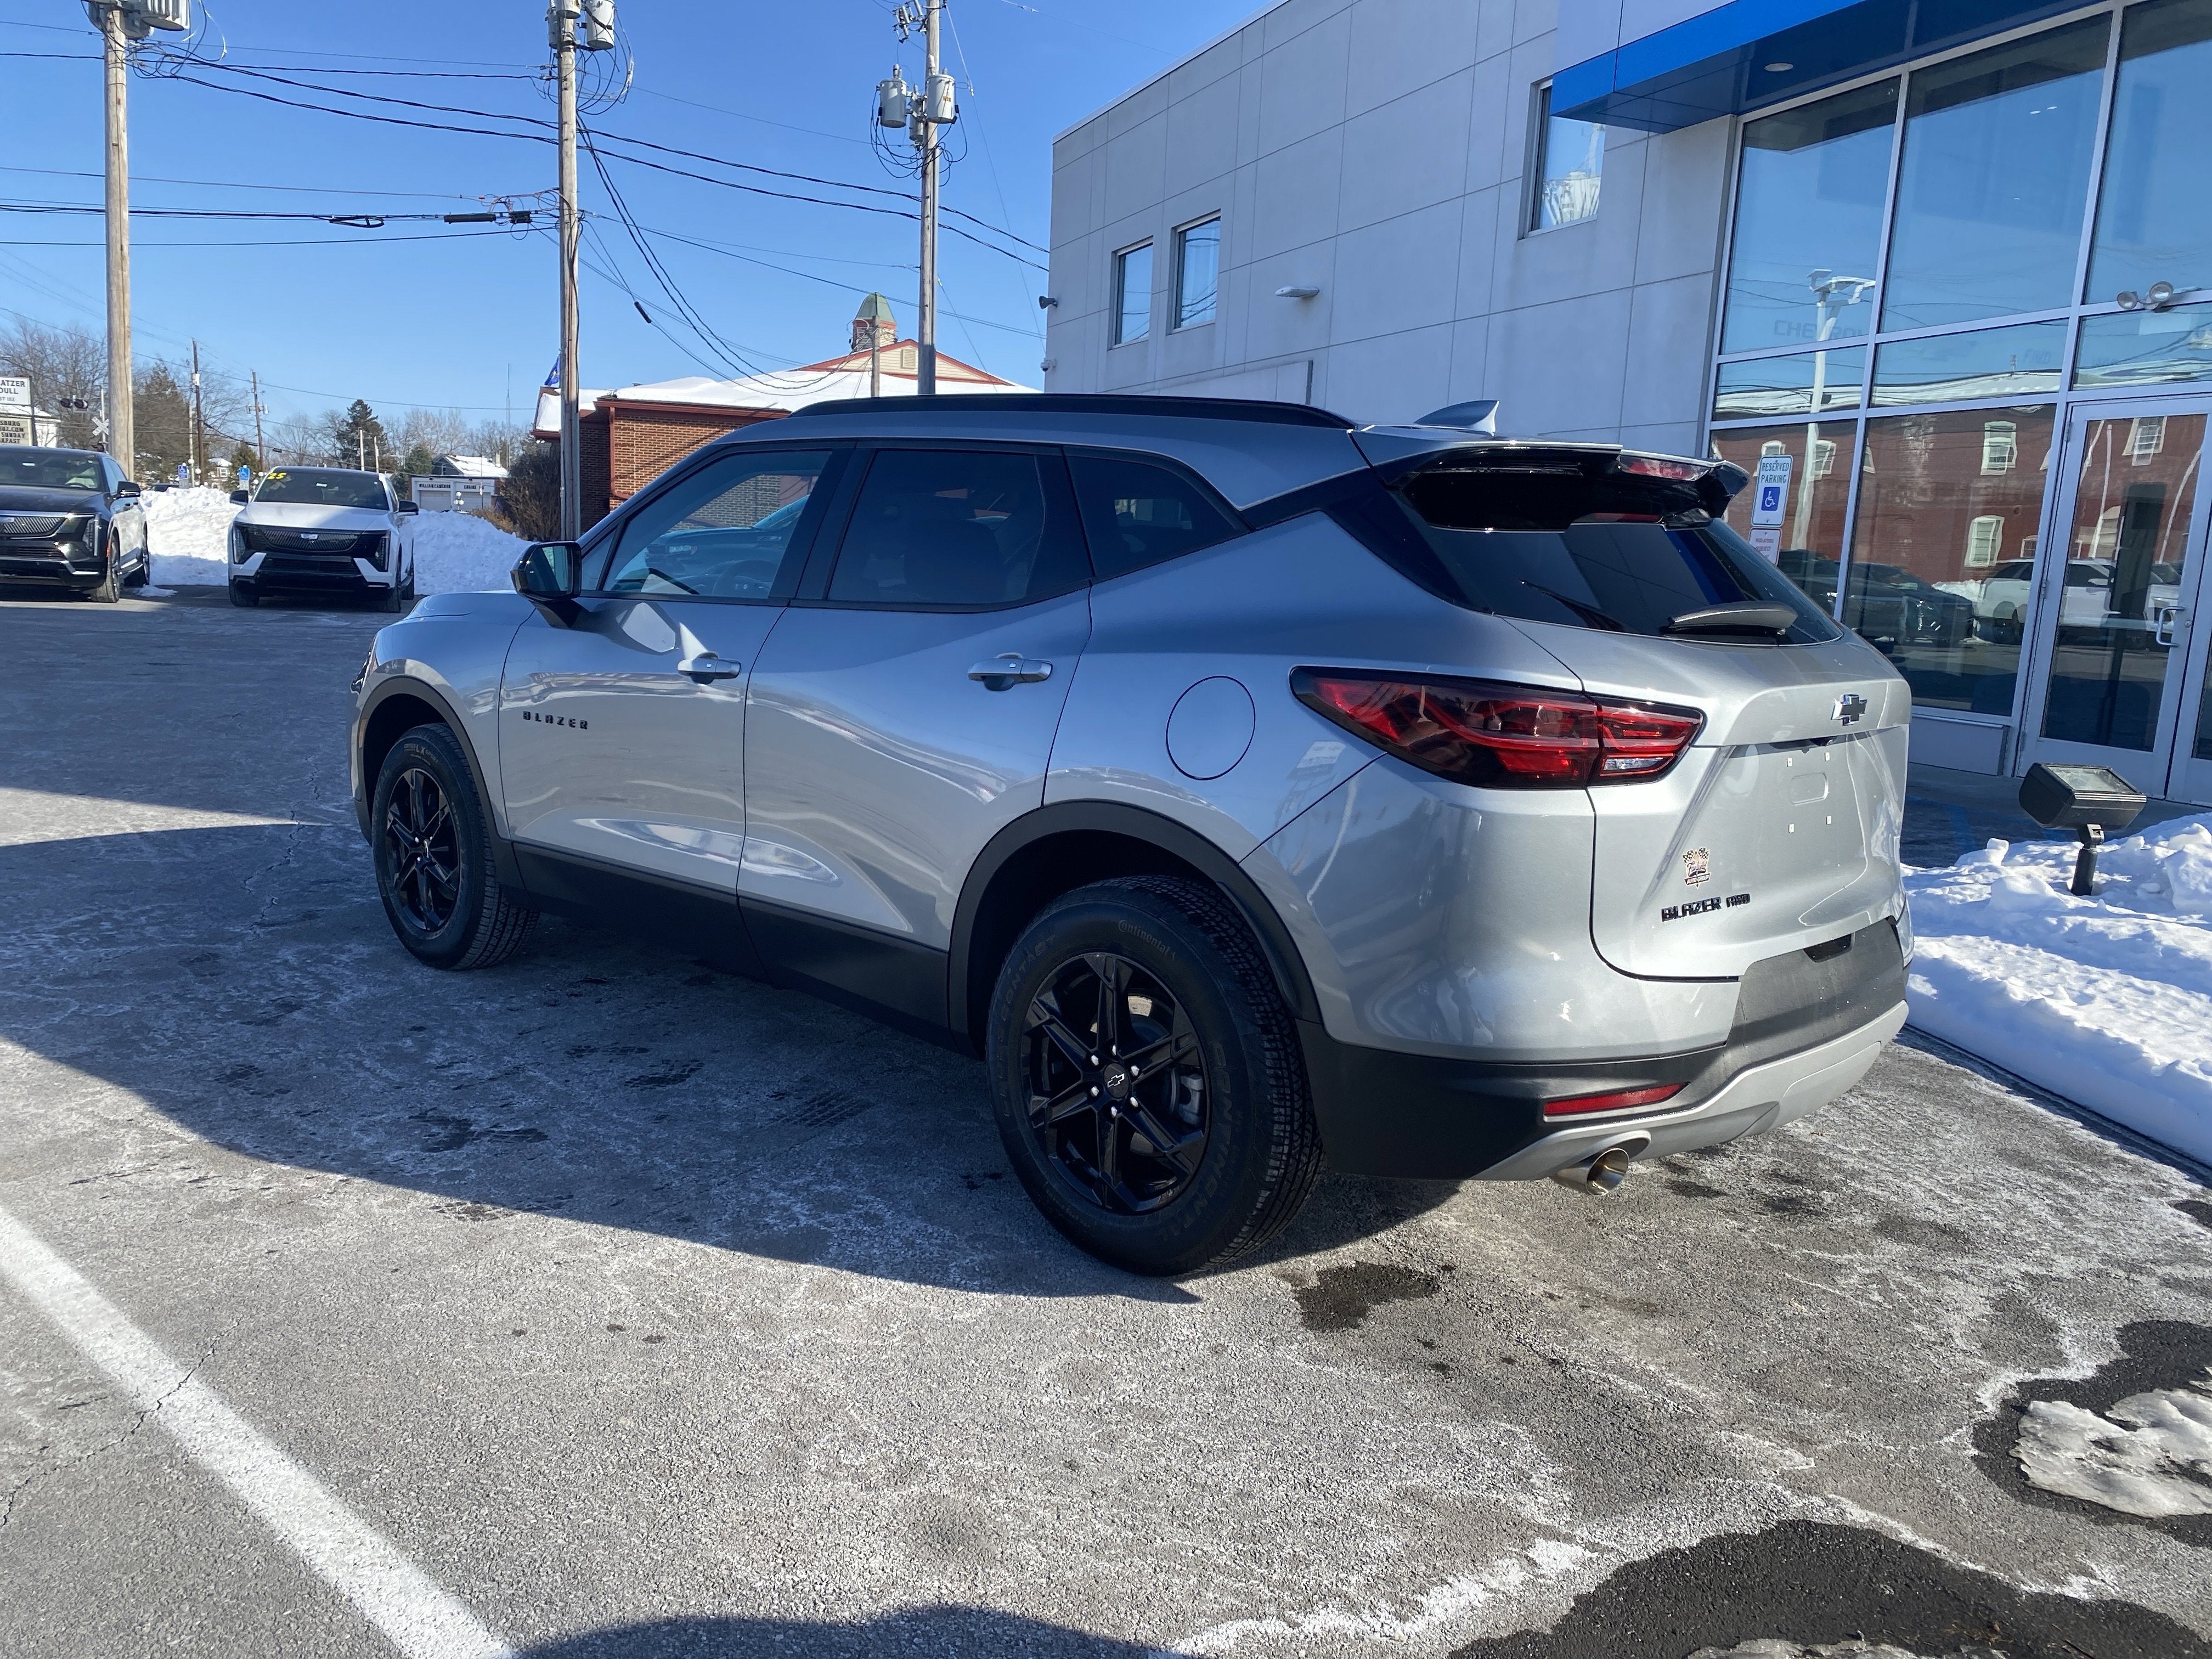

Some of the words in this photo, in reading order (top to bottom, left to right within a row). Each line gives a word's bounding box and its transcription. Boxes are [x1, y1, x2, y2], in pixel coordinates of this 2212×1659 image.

[1761, 462, 1790, 471] RESERVED
[1760, 475, 1786, 483] PARKING
[523, 710, 588, 730] BLAZER
[1661, 896, 1722, 922] BLAZER
[1118, 919, 1171, 957] Continental
